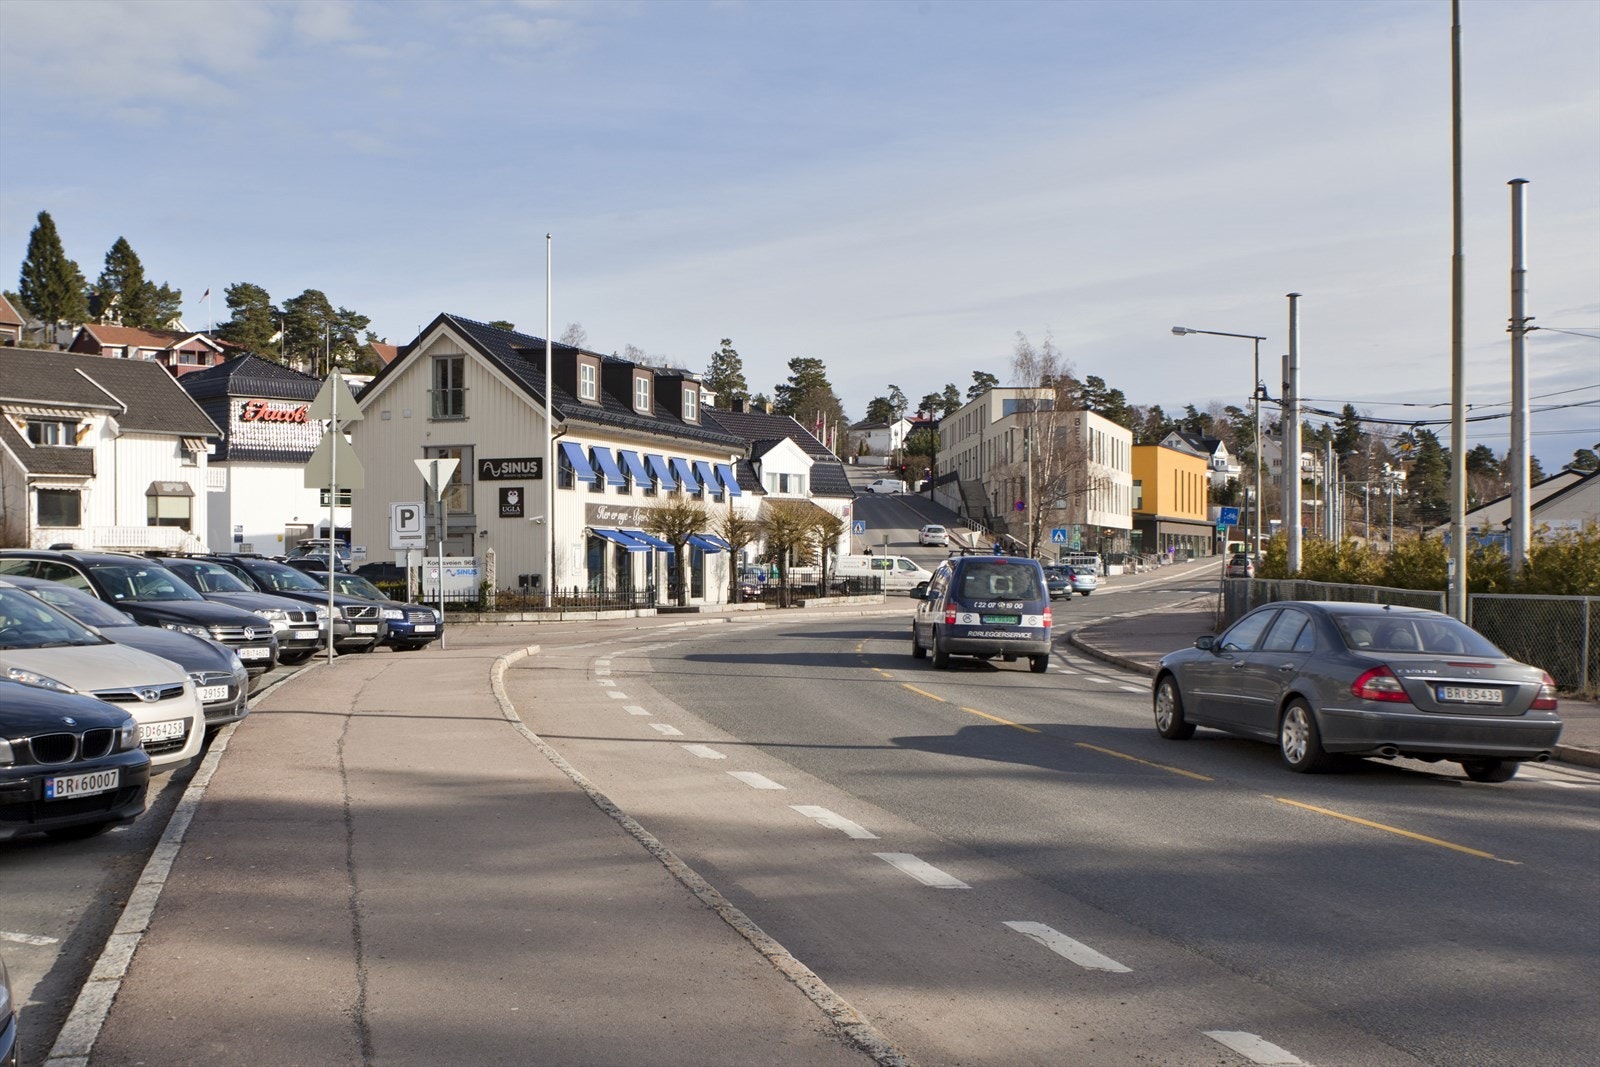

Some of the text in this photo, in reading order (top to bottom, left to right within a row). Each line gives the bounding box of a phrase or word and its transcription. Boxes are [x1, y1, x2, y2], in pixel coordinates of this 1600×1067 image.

[501, 461, 538, 473] SINUS
[400, 508, 415, 529] P
[456, 568, 478, 576] SINUS
[203, 687, 225, 699] 29155
